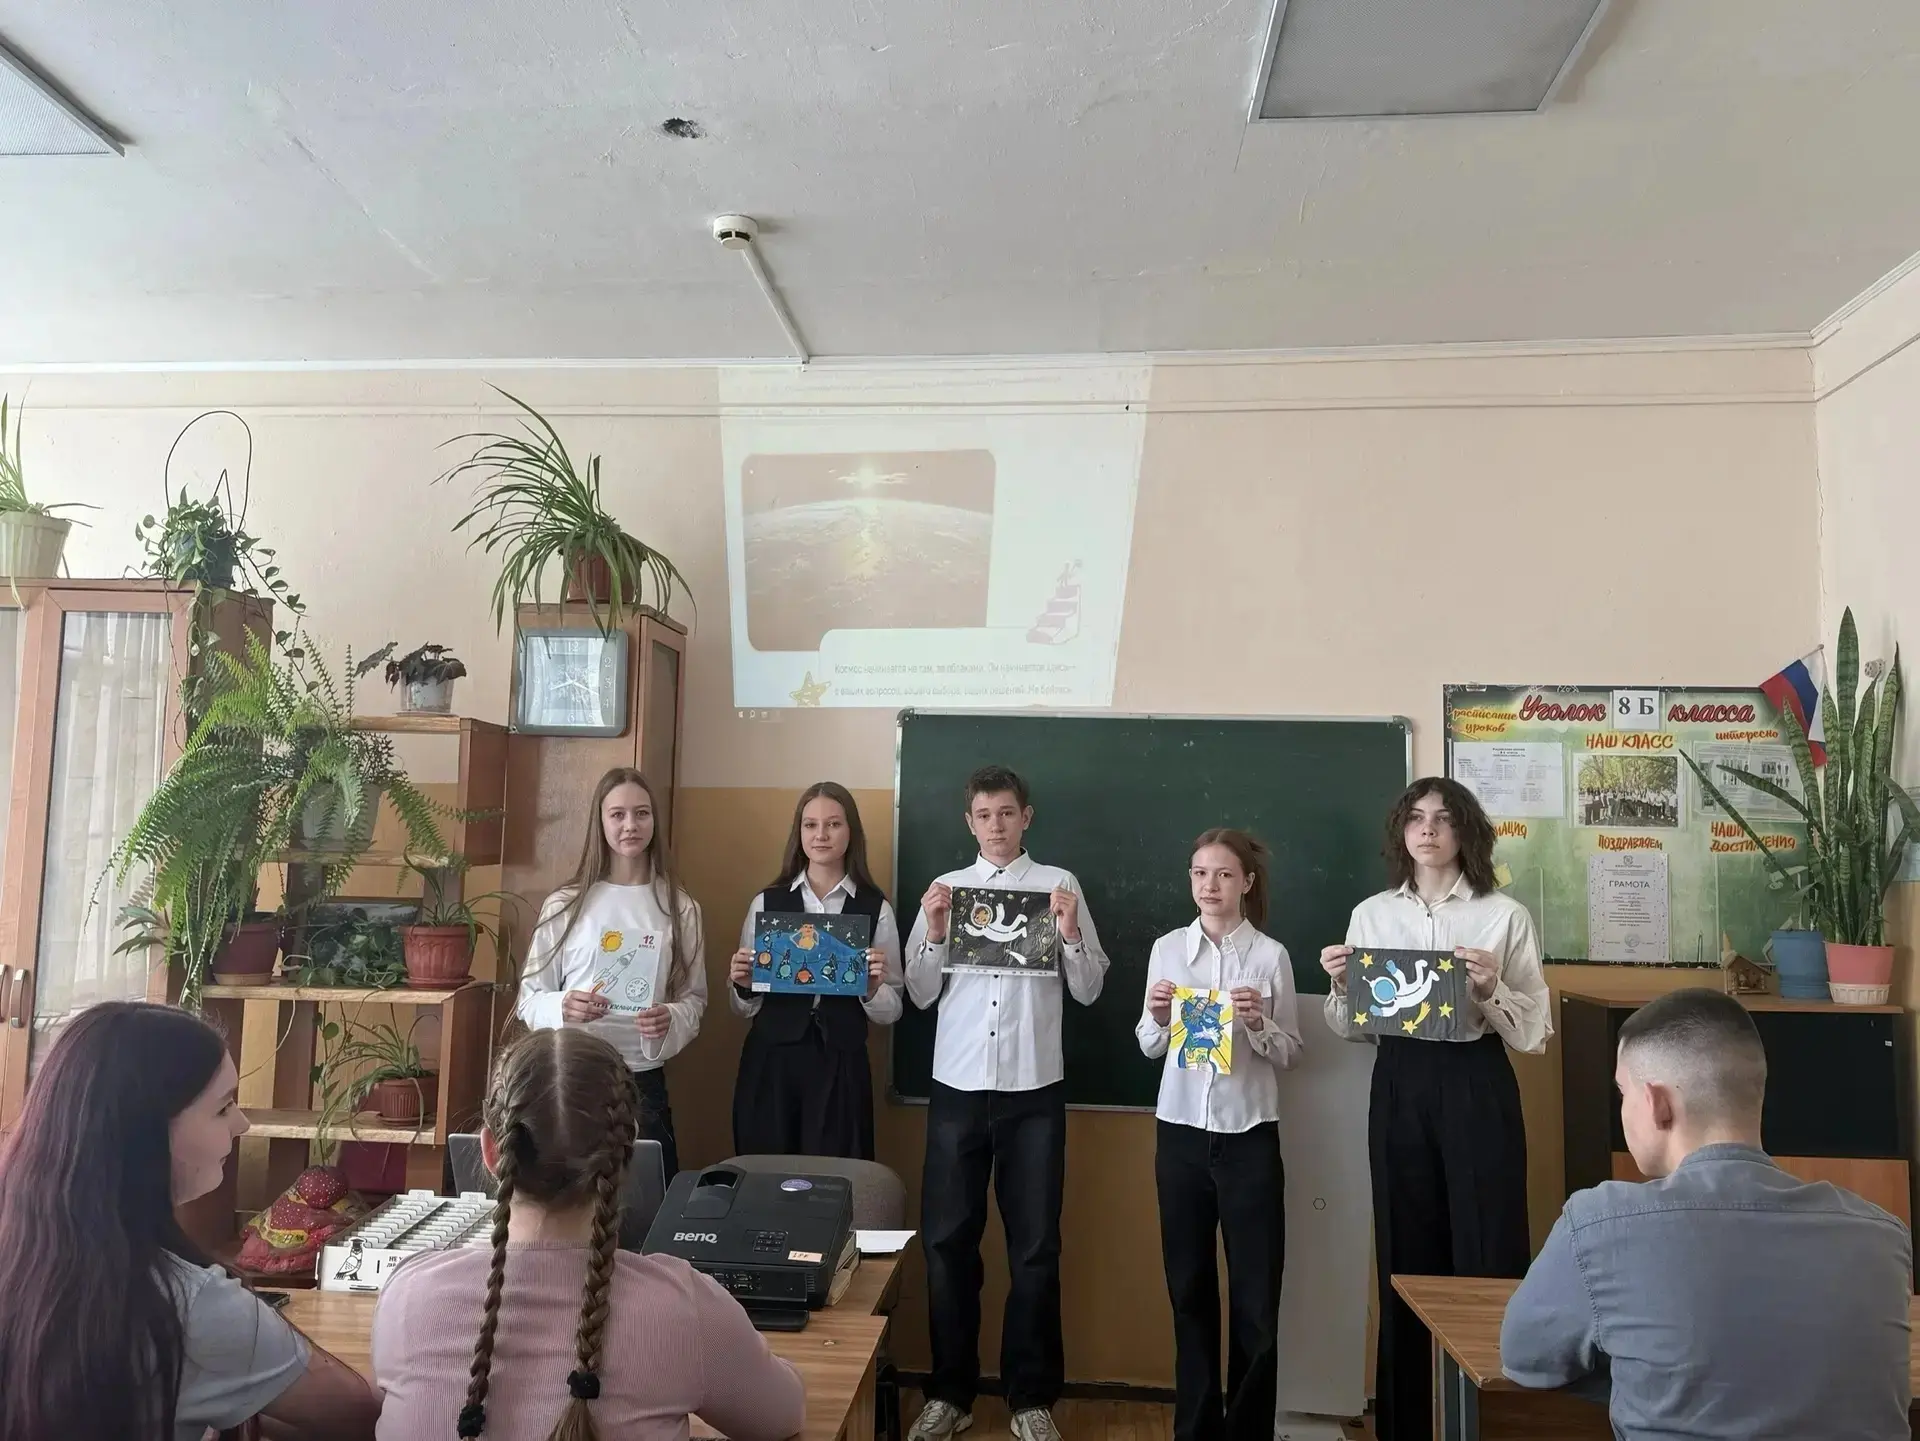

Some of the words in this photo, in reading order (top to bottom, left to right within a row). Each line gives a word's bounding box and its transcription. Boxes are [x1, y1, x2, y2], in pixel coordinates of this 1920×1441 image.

[1518, 694, 1607, 722] Уголок
[1618, 697, 1631, 714] 8
[1639, 697, 1654, 715] Б
[1668, 703, 1756, 722] класса
[1453, 708, 1517, 721] расписание
[1465, 722, 1506, 734] уроков
[1586, 733, 1618, 749] НАШ
[1622, 733, 1674, 749] КЛАСС
[1715, 729, 1779, 743] интересно
[1711, 821, 1745, 838] НАШИ
[1598, 834, 1663, 851] ПОЗДРАВЛЯЕМ
[1609, 880, 1651, 889] ГРАМОТА
[643, 935, 655, 945] 12
[673, 1232, 718, 1243] BenQ
